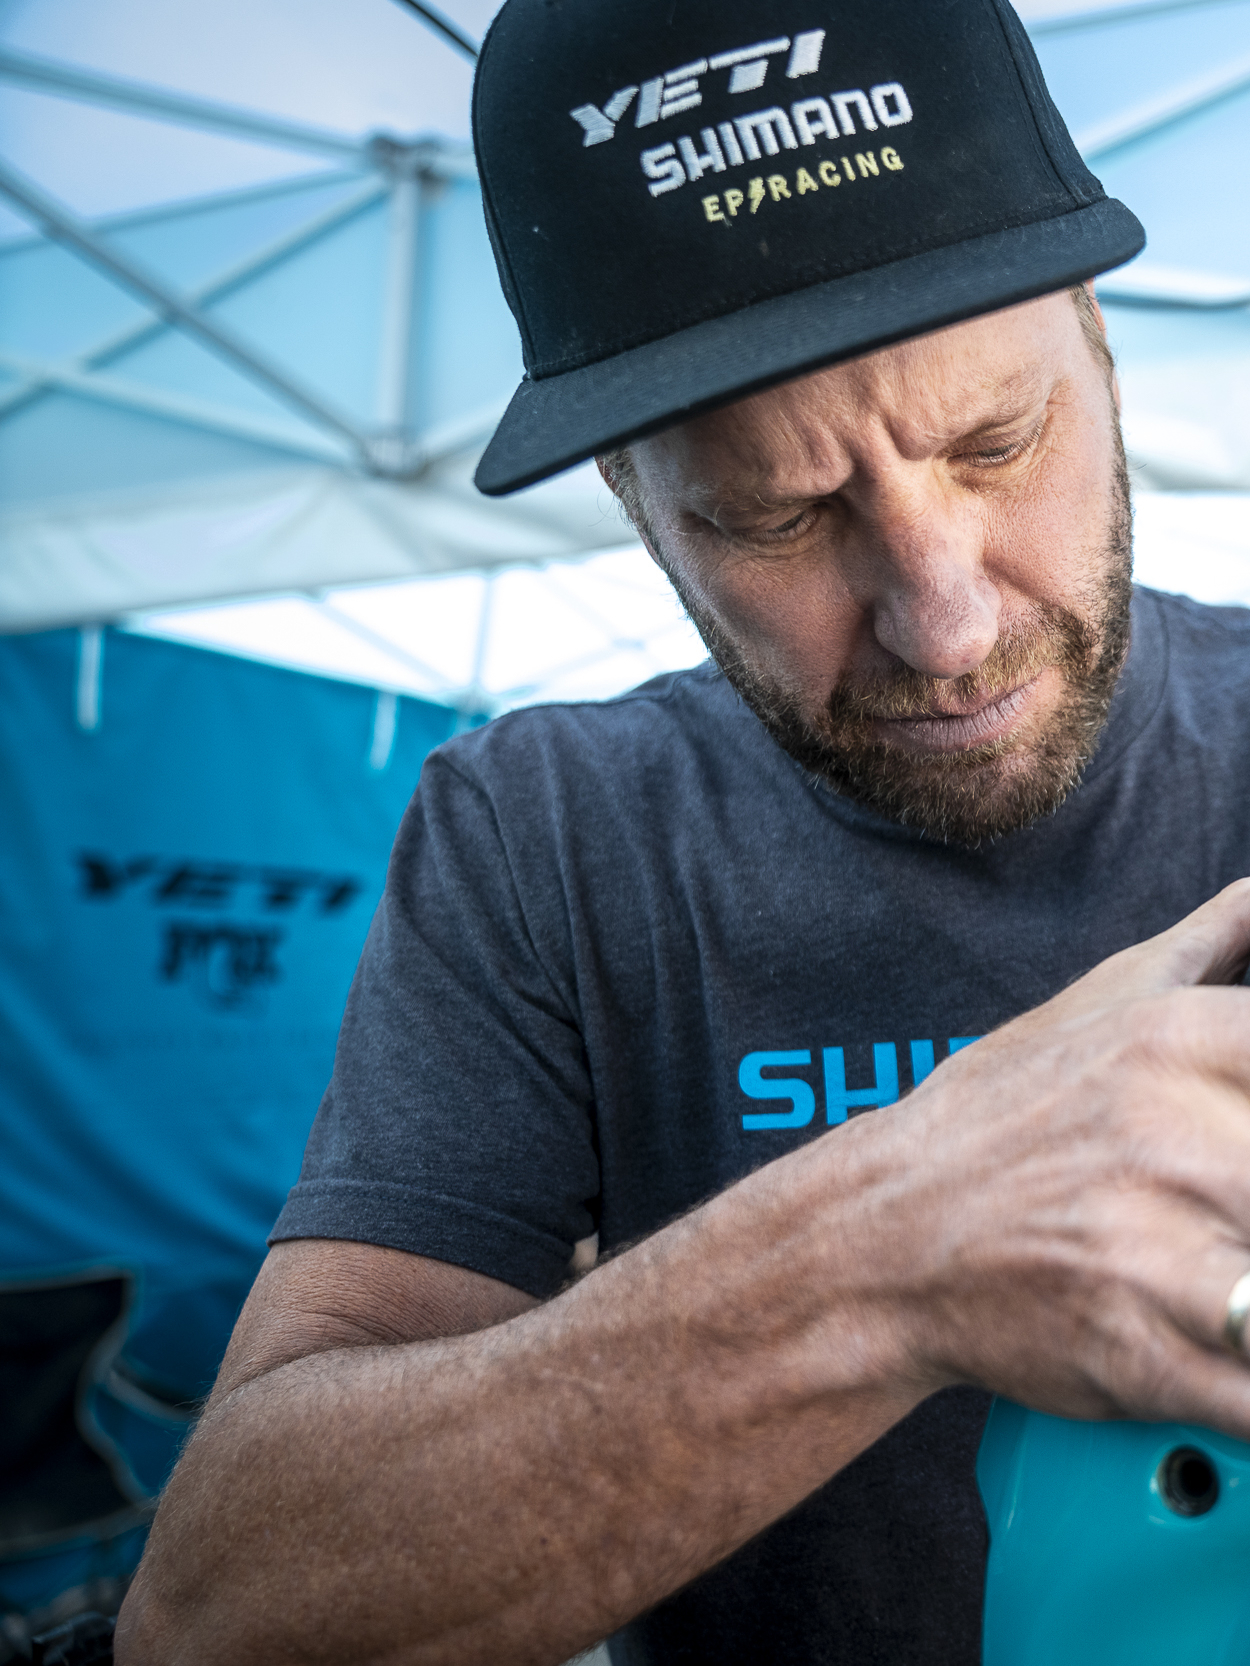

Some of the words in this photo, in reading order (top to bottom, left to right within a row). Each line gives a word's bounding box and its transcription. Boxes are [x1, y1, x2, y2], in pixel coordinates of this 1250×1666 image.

[570, 29, 826, 147] YETI
[641, 82, 913, 197] SHIMANO
[76, 852, 361, 915] YETI
